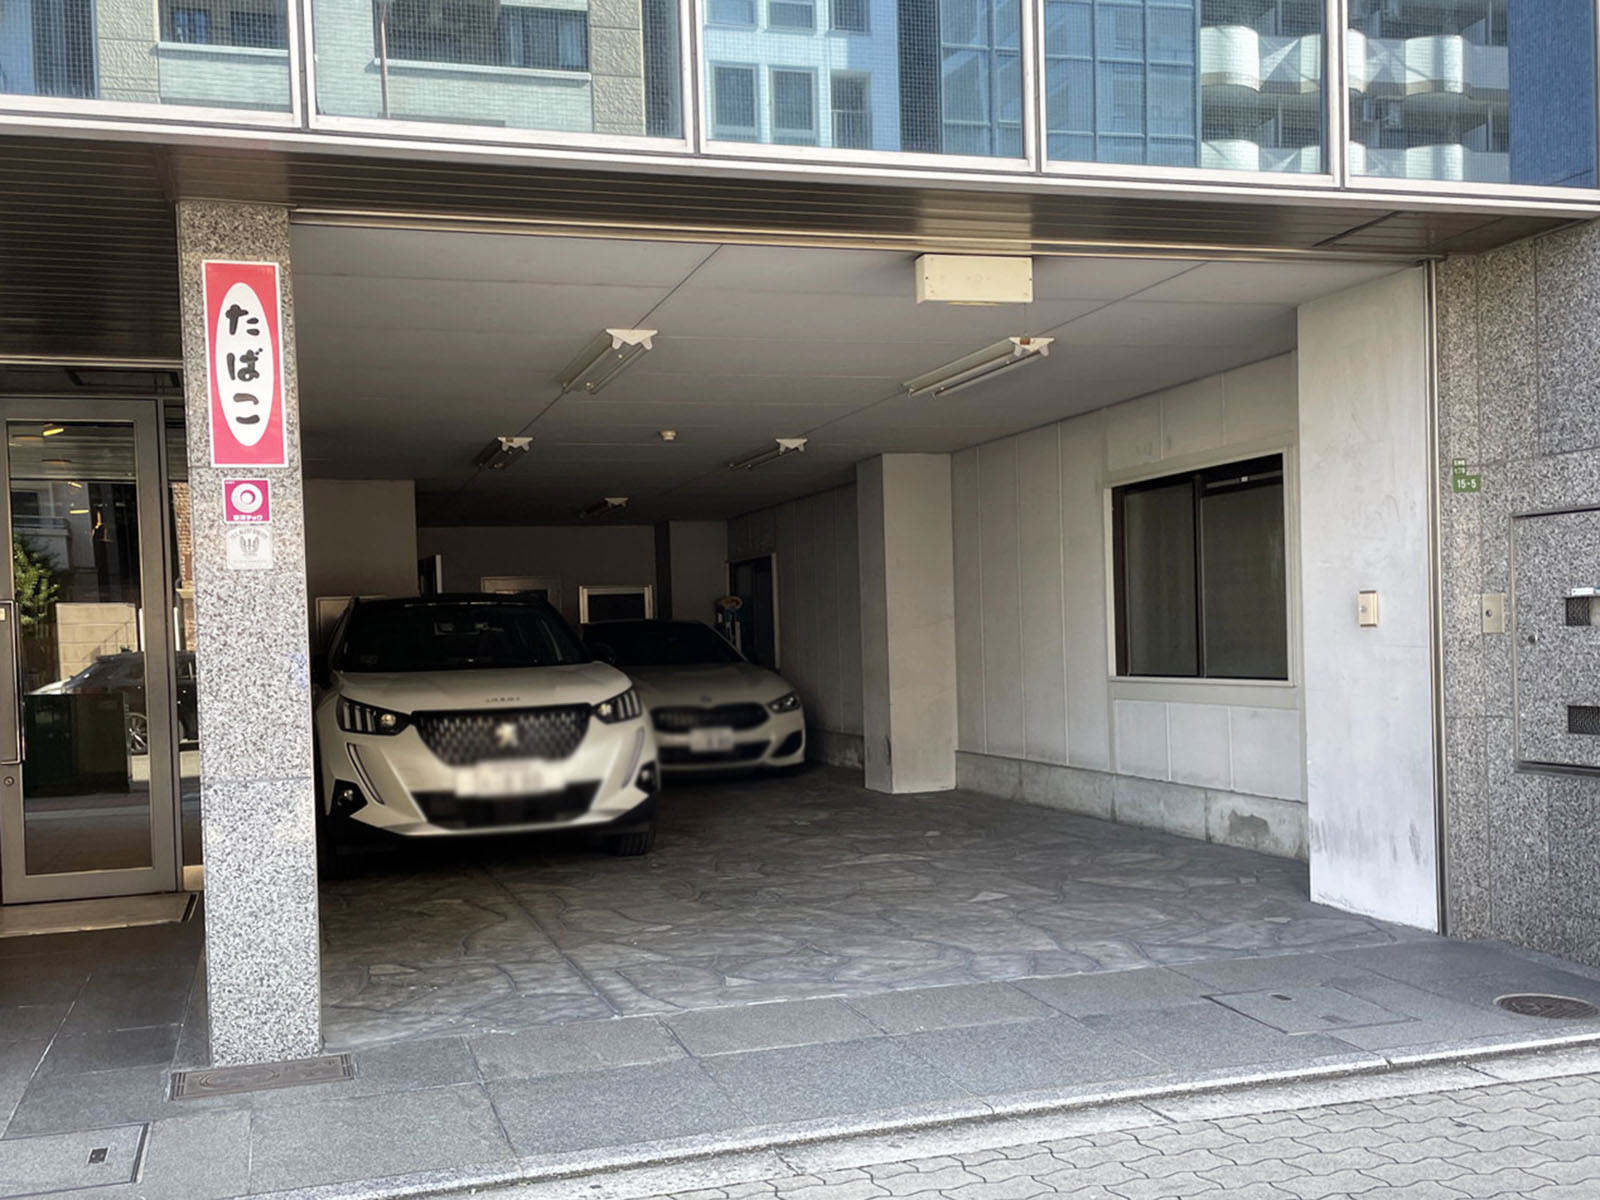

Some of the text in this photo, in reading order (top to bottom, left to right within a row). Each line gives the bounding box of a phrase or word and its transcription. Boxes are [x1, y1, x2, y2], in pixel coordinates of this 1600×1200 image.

[225, 304, 263, 425] たばこ
[1457, 479, 1477, 489] 15-5
